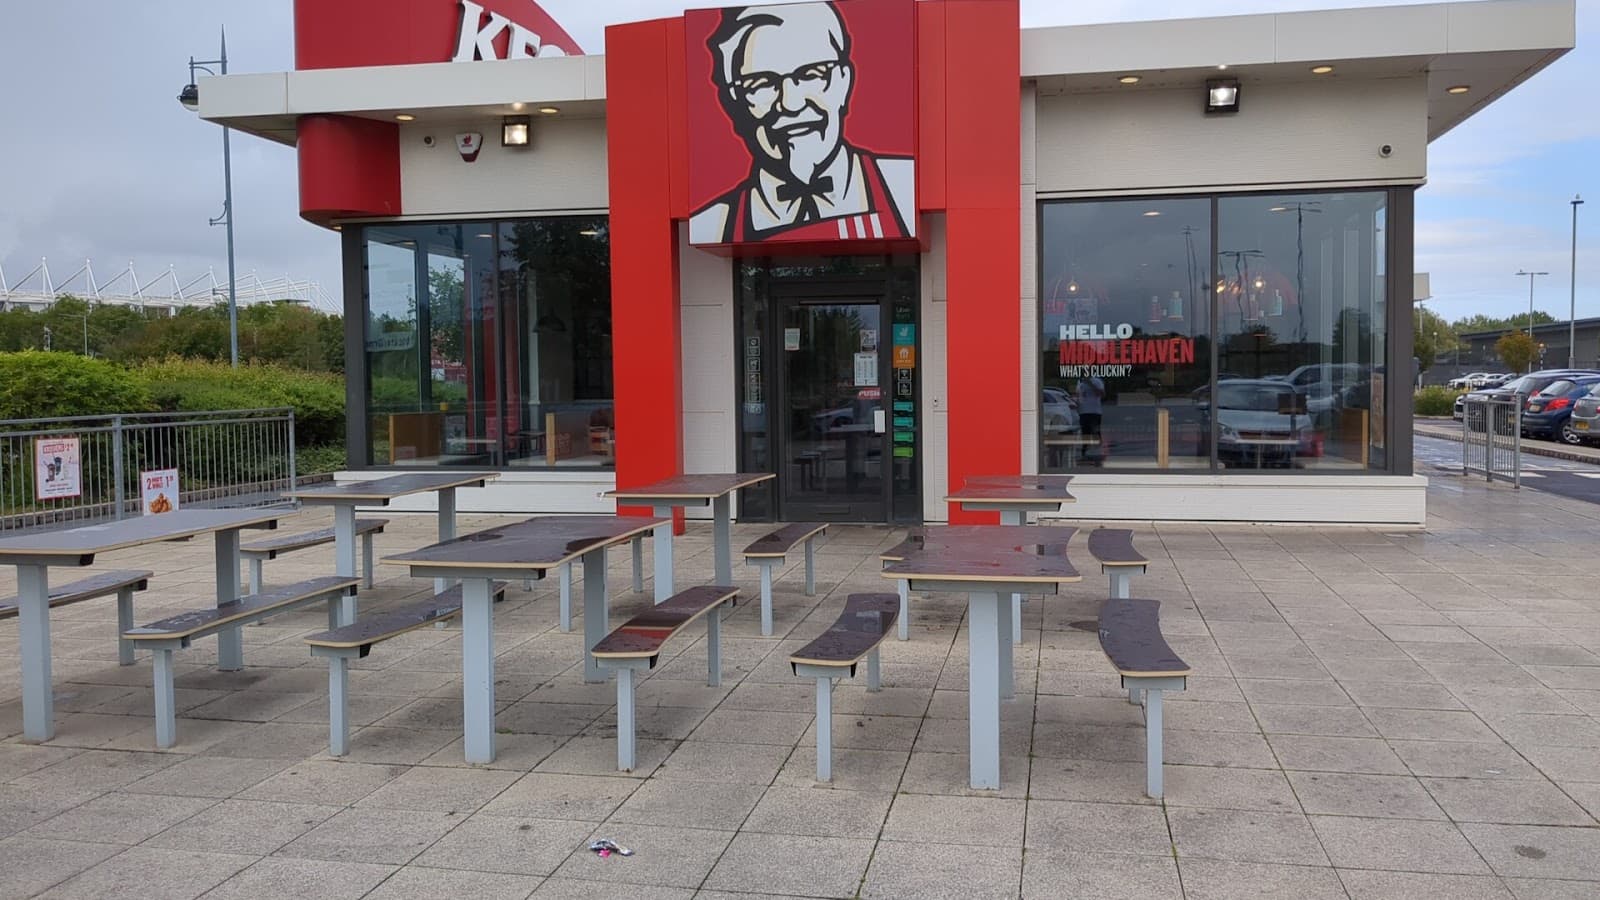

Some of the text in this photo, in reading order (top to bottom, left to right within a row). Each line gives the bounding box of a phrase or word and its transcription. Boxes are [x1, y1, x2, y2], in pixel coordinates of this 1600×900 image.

[452, 0, 567, 62] KF
[1059, 323, 1133, 340] HELLO
[1059, 338, 1195, 364] MIDDLEHAVEN
[1059, 364, 1133, 378] WHAT'S CLUCKIN'?
